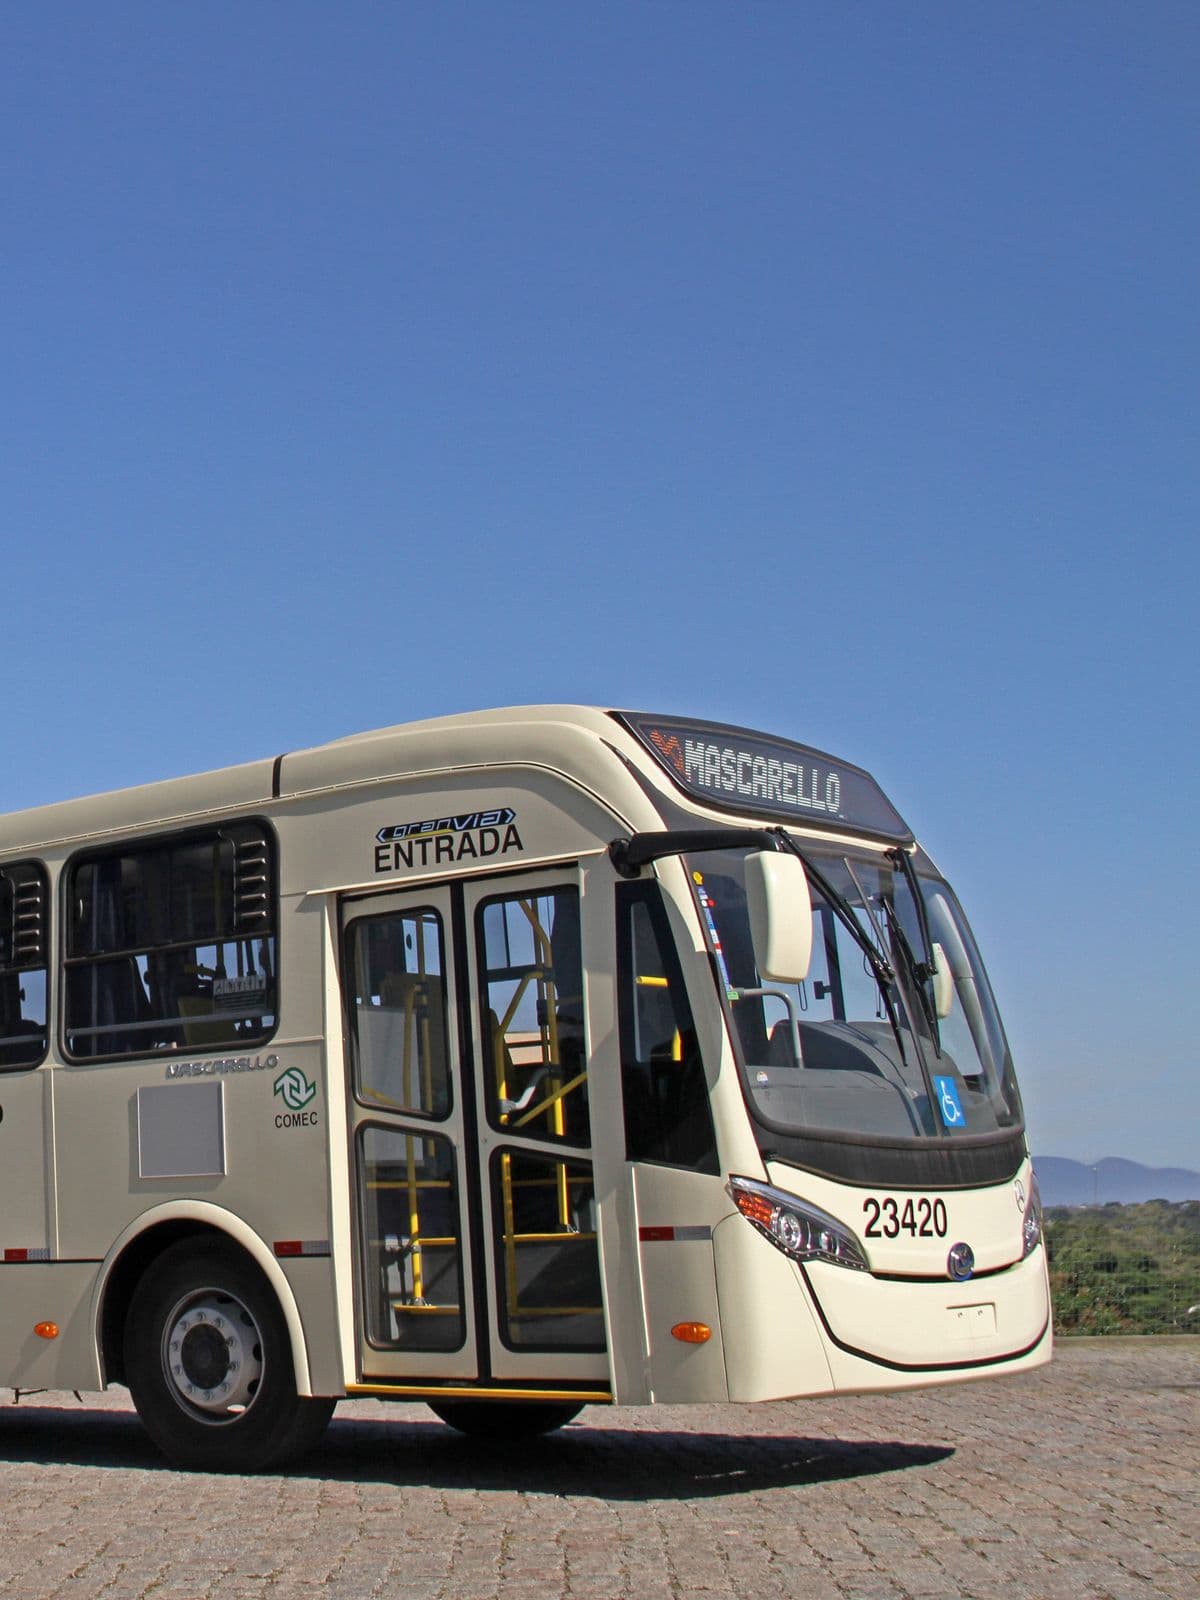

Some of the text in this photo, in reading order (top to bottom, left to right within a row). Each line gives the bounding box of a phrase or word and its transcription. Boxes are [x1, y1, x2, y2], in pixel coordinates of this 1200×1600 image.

[684, 739, 841, 813] MASCARELLO
[374, 823, 524, 873] ENTRADA
[274, 1111, 319, 1129] COMEC
[863, 1197, 948, 1238] 23420
